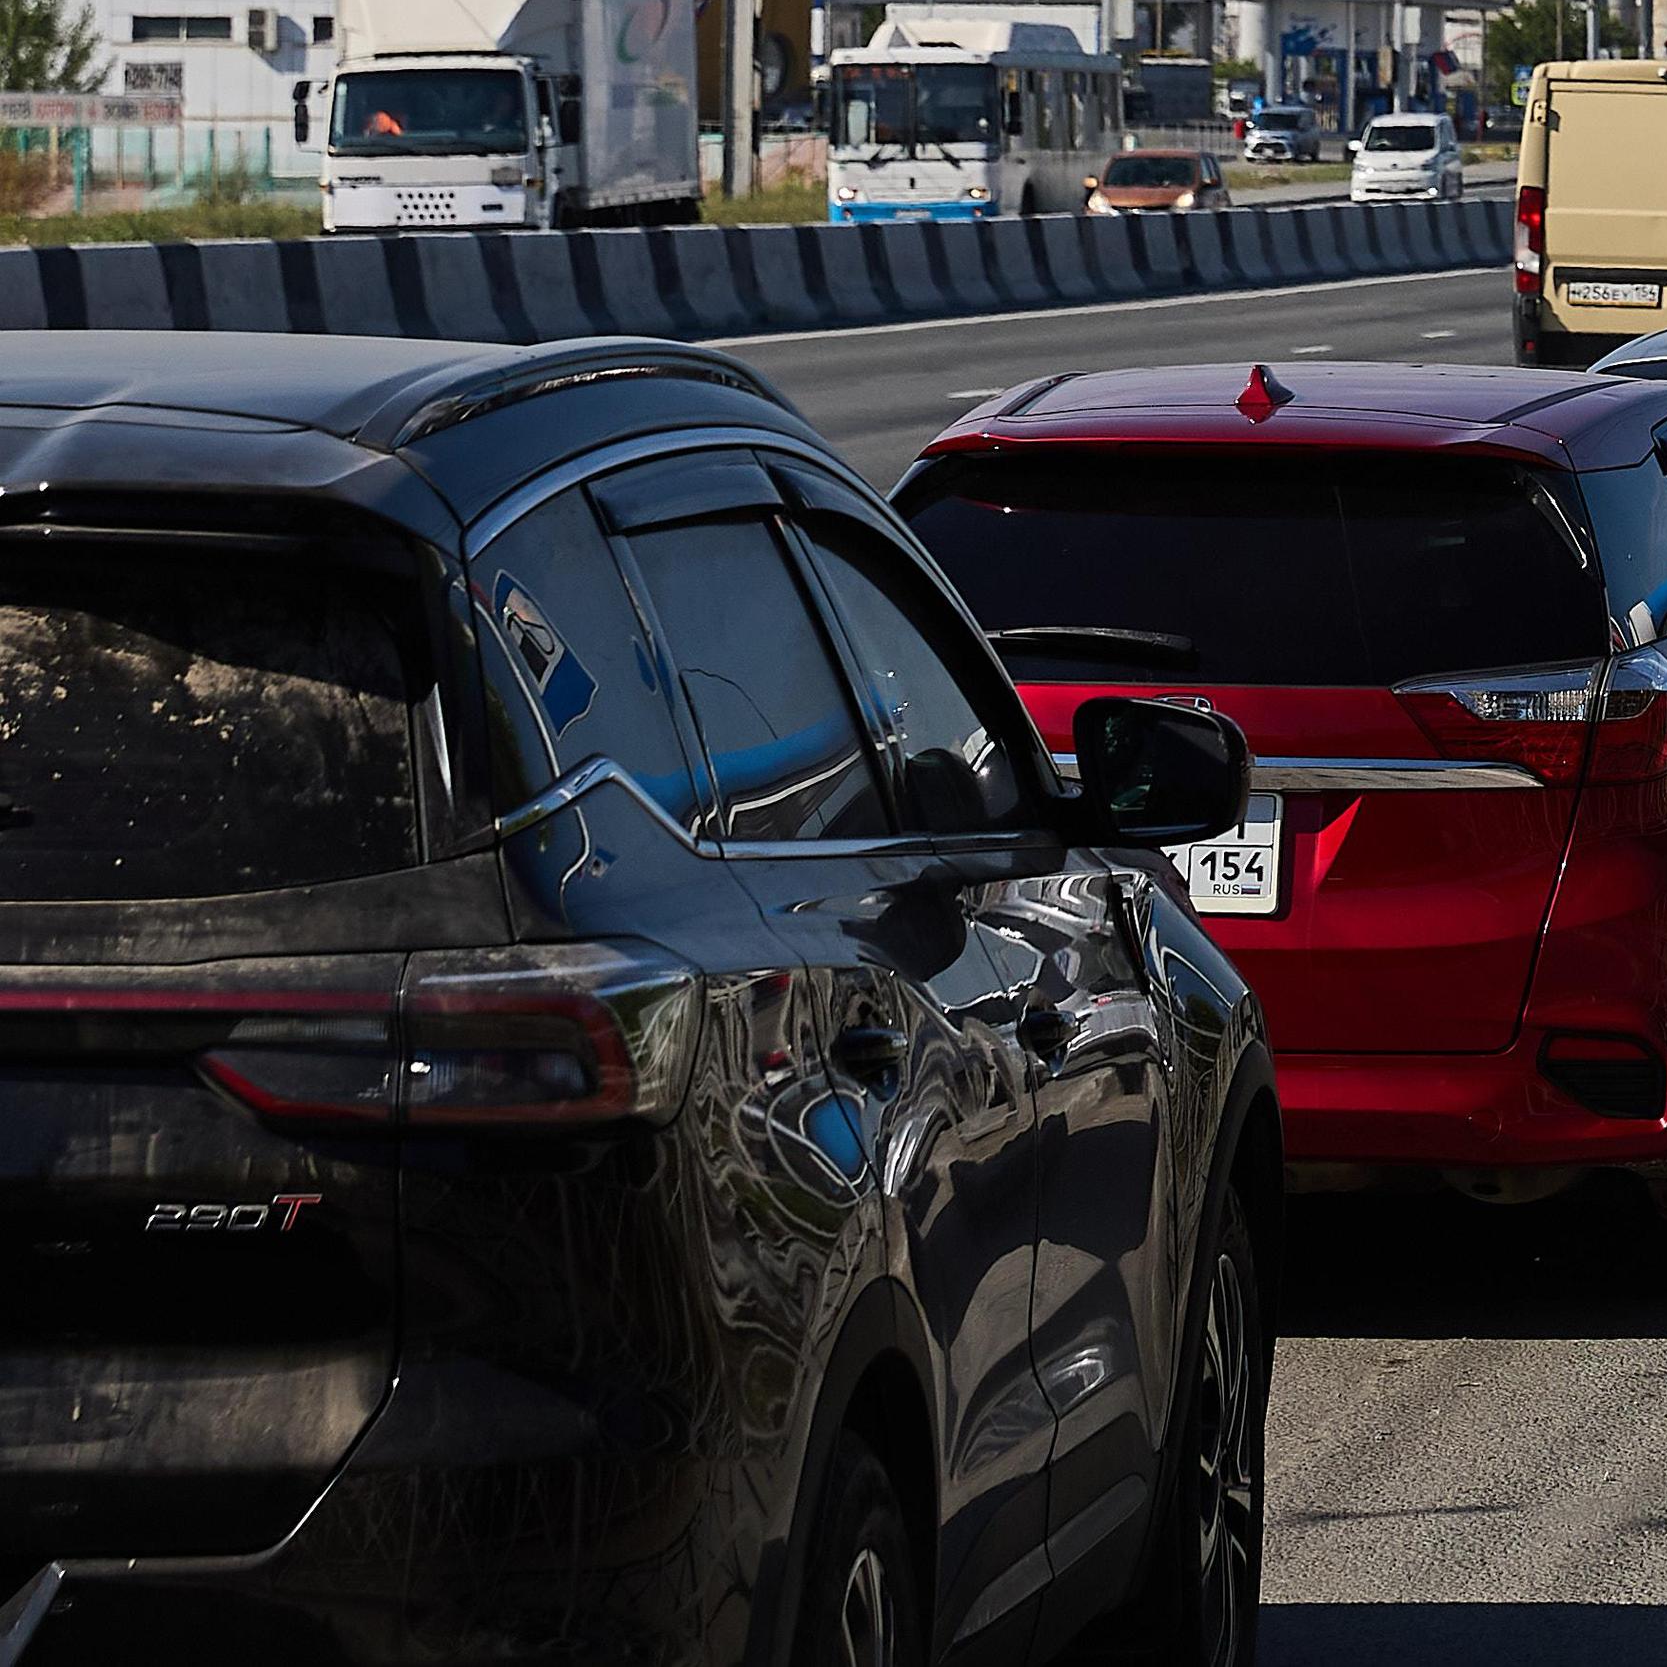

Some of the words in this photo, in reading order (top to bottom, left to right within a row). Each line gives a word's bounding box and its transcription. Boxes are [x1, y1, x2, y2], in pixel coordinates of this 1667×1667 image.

[1199, 850, 1265, 883] 154
[1212, 883, 1241, 896] RUS
[145, 1193, 323, 1231] 290T
